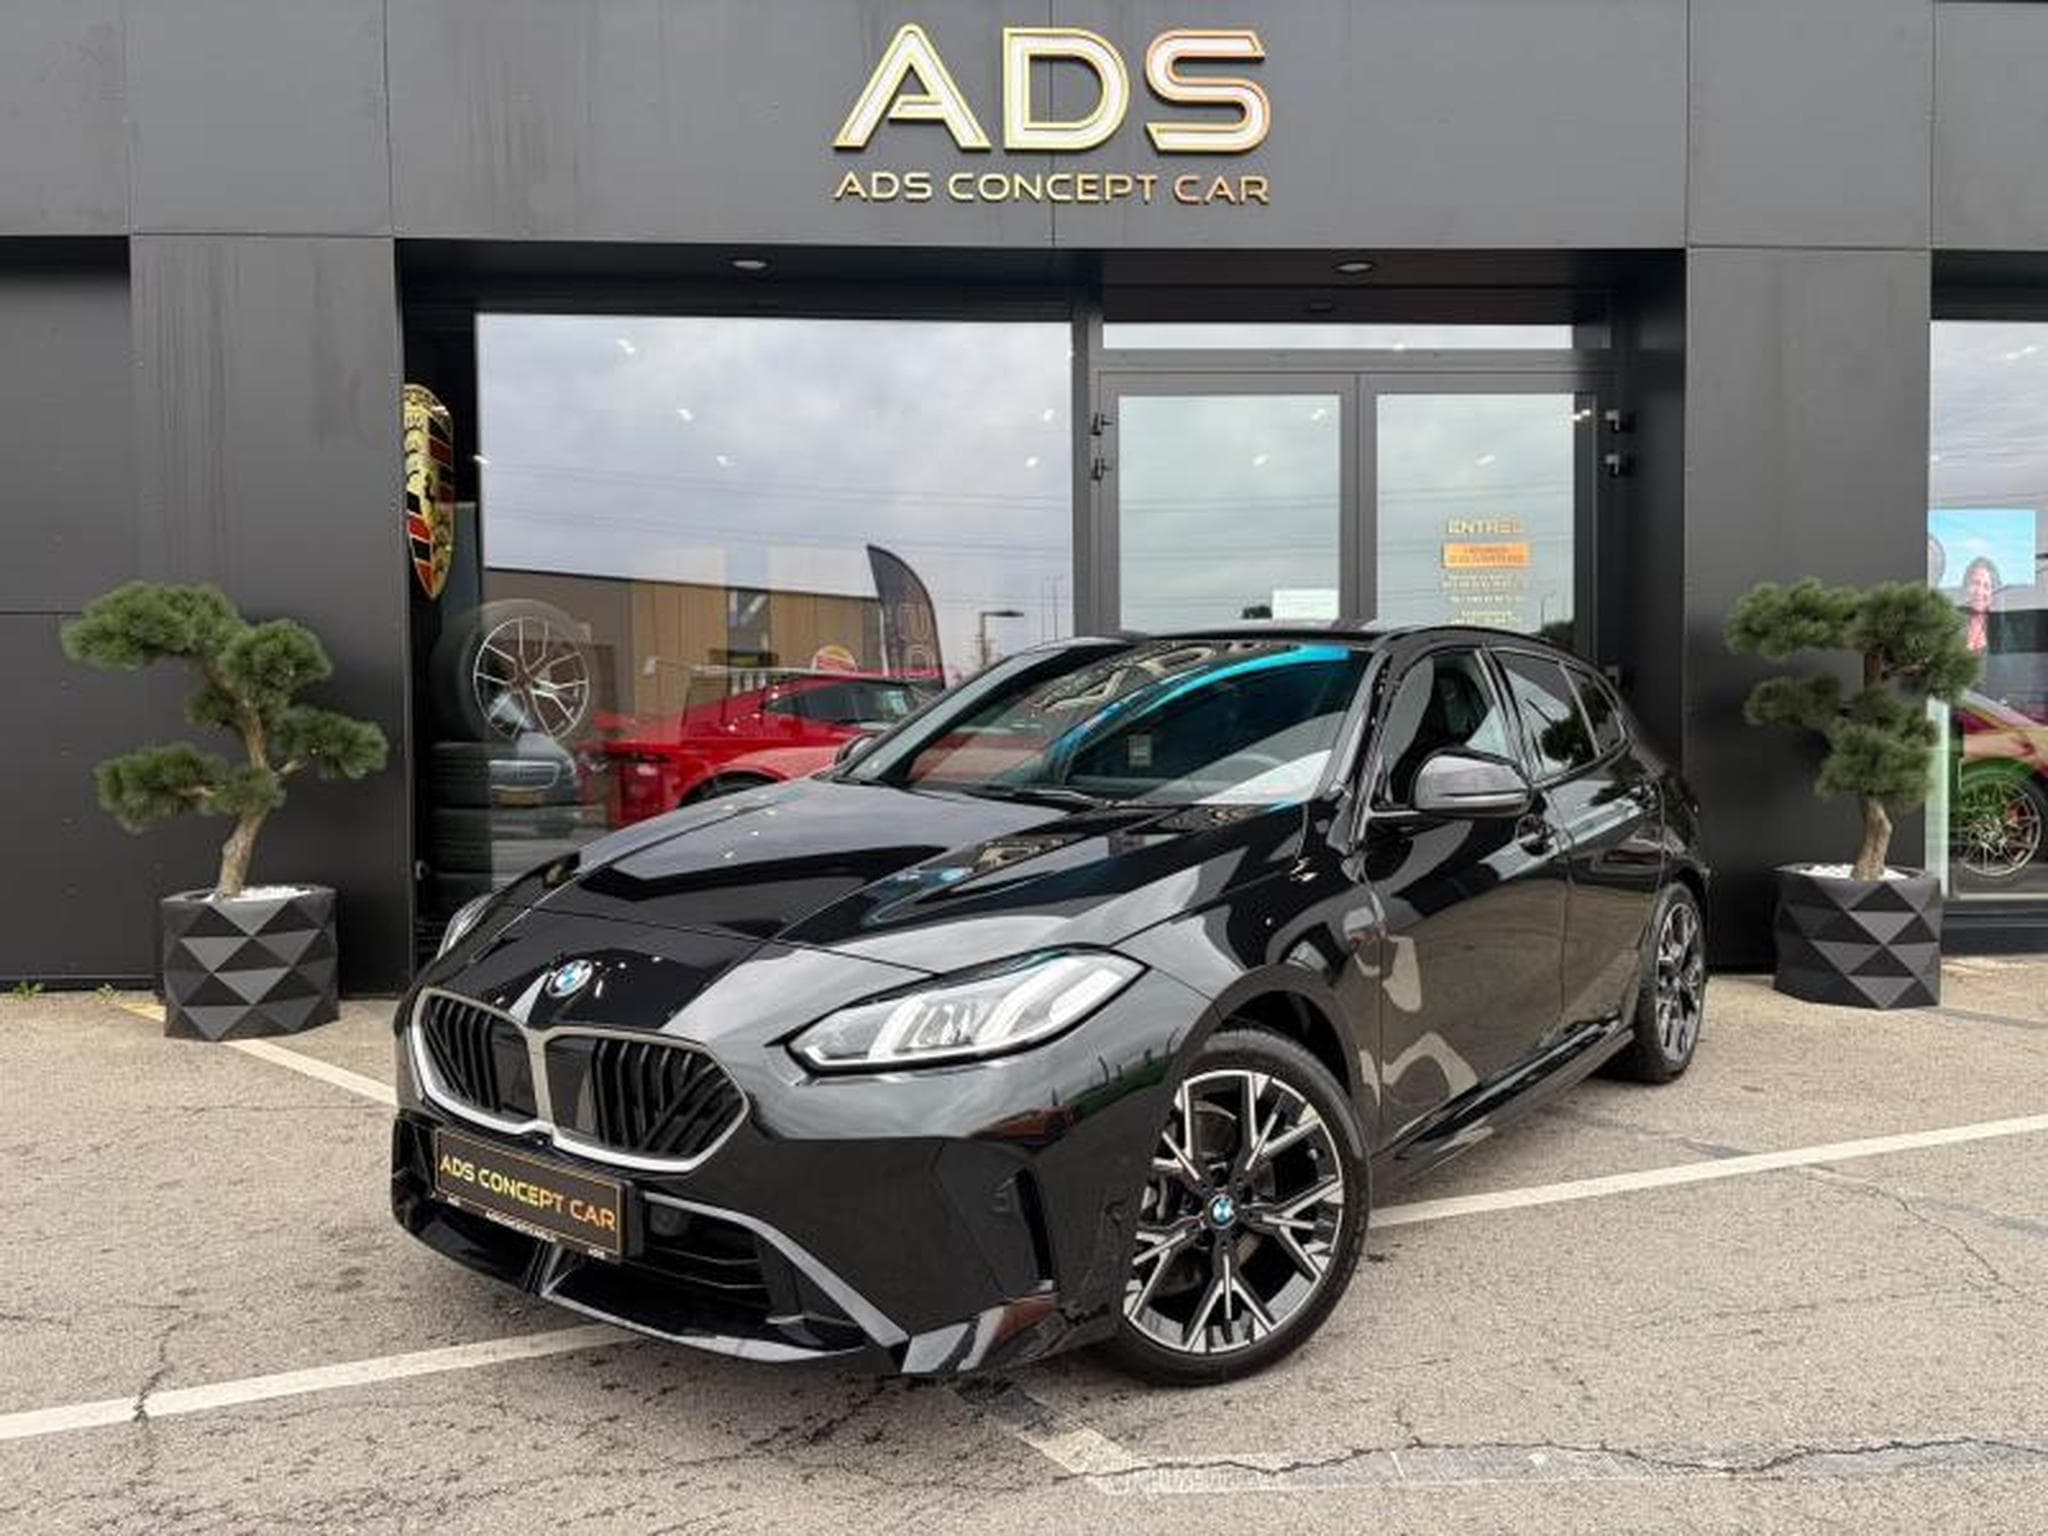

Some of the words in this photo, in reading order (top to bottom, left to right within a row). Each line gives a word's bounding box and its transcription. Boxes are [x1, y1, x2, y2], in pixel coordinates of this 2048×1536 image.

[832, 22, 1272, 153] ADS
[834, 171, 934, 202] ADS
[947, 171, 1159, 203] CONCEPT
[1173, 174, 1271, 205] CAR
[439, 1153, 476, 1182] ADS
[477, 1167, 565, 1214] CONCEPT
[569, 1199, 617, 1231] CAR
